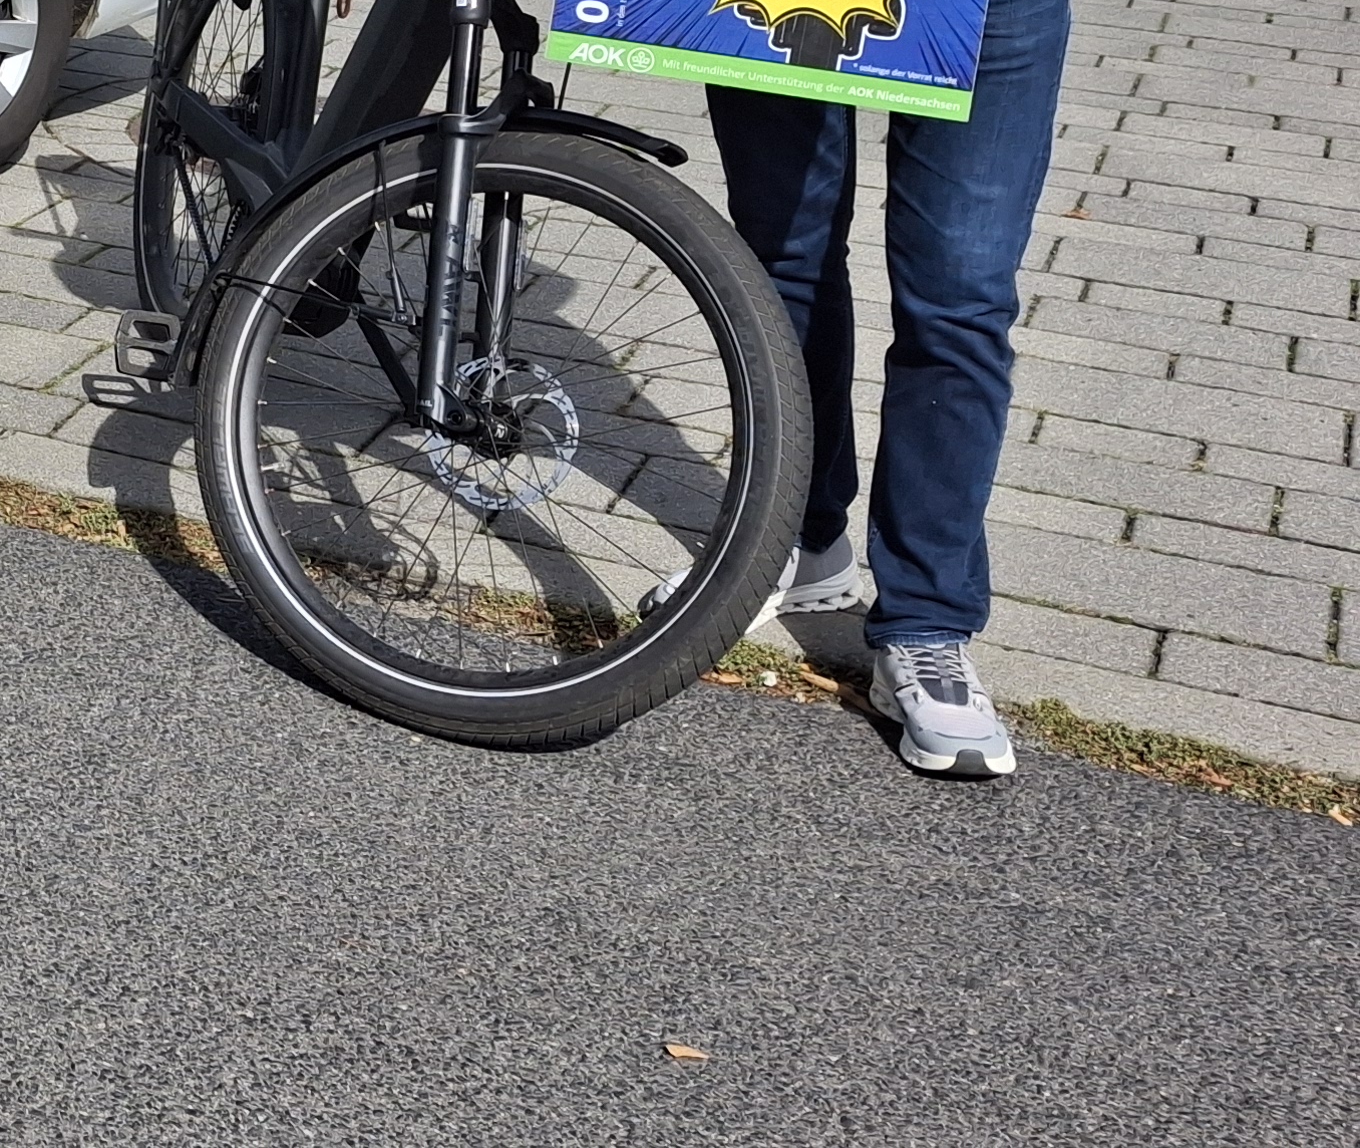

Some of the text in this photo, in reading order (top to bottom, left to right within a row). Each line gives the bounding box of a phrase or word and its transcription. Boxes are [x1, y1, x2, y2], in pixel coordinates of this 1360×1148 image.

[569, 42, 626, 67] AOK
[662, 58, 961, 112] Mit freundlicher Unterstützung der AOK Niedersachsen
[891, 67, 906, 78] der
